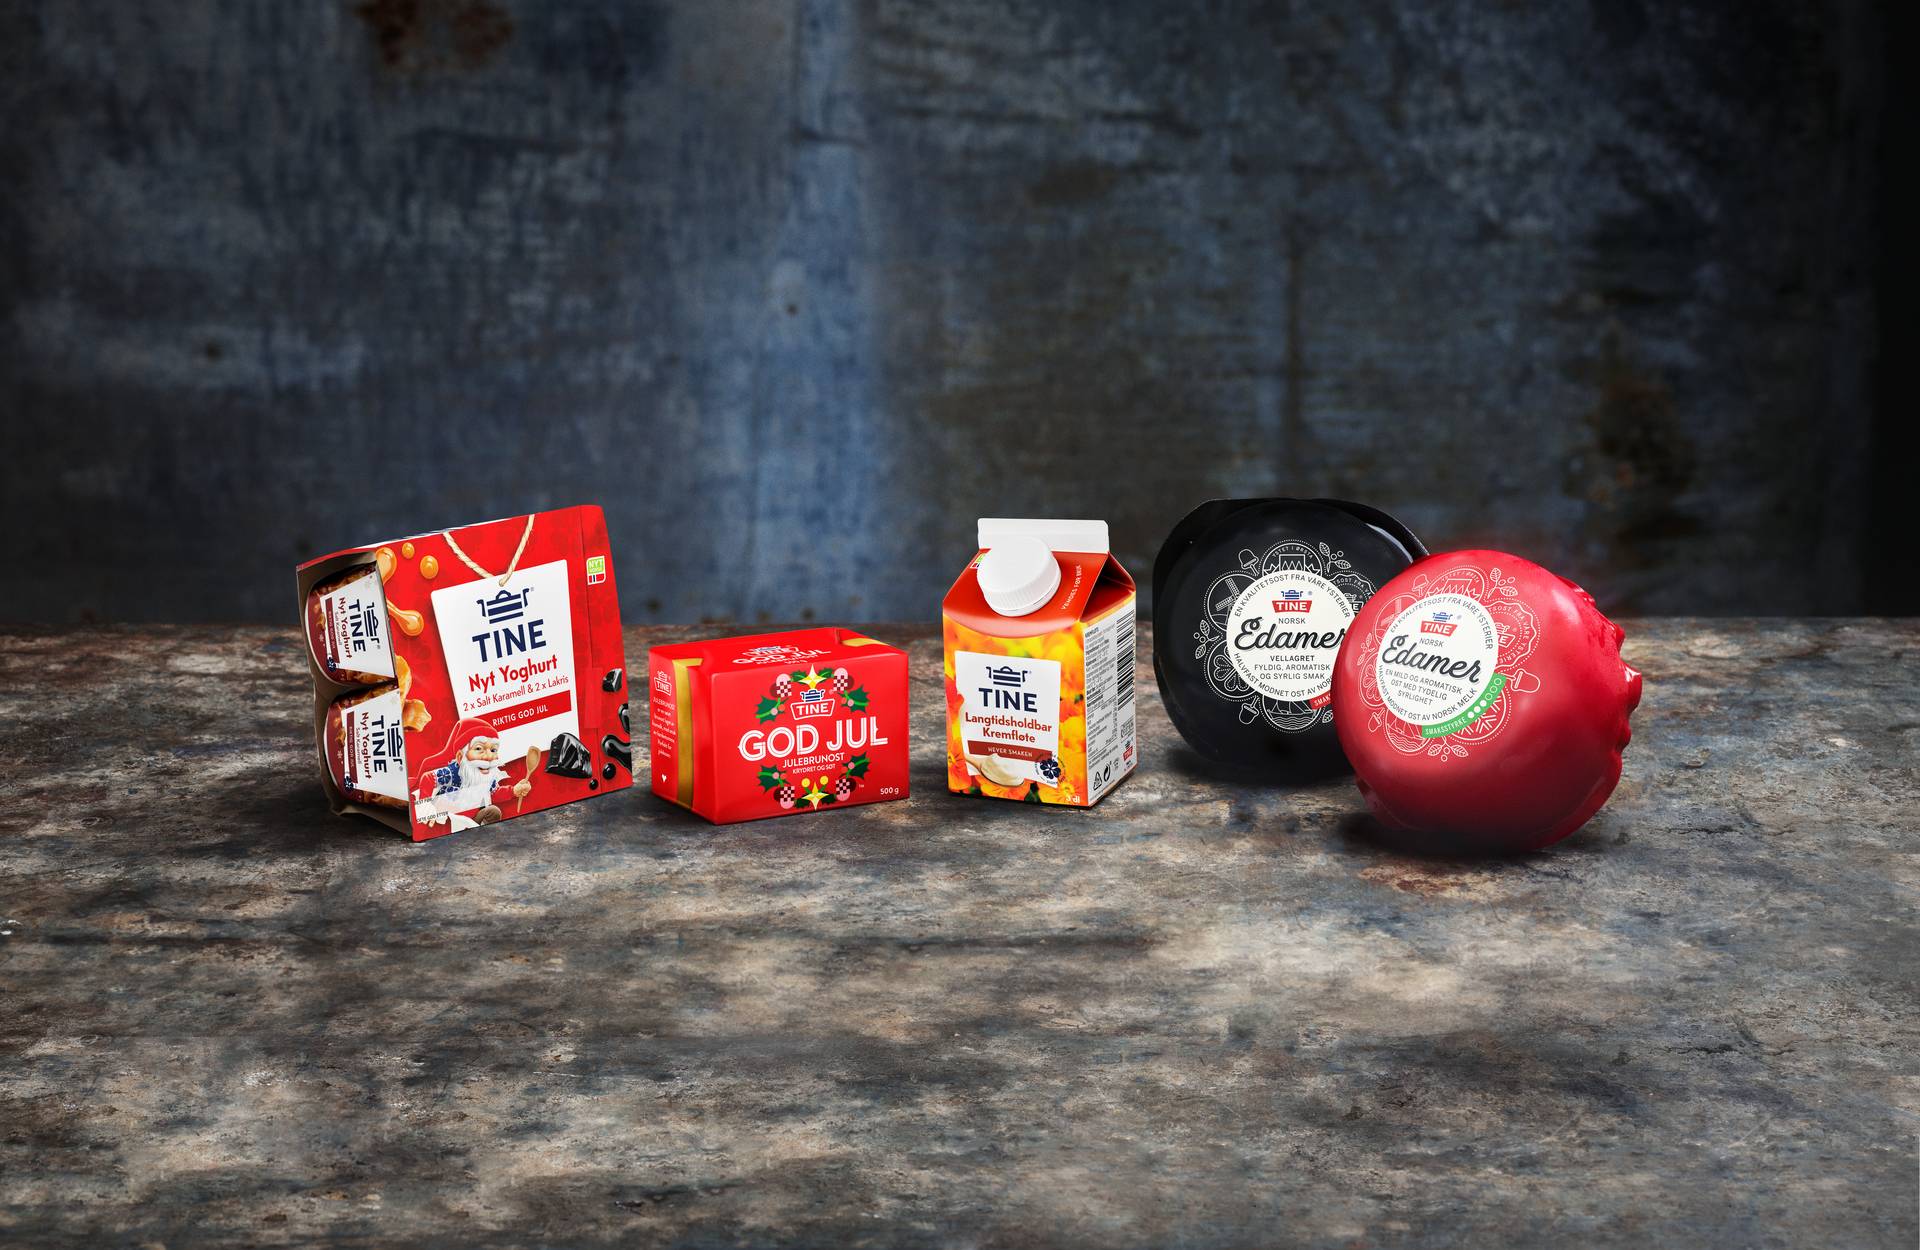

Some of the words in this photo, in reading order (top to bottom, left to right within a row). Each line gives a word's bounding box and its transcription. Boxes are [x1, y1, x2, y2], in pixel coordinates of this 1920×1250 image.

[1272, 546, 1288, 557] YSTET
[589, 559, 602, 568] NYT
[1061, 589, 1077, 609] VENDES
[1234, 606, 1243, 617] EN
[1240, 574, 1289, 606] KVALITETSOST
[1325, 586, 1351, 618] YSTERIER
[338, 597, 346, 615] Nyt
[1276, 602, 1307, 610] TINE
[1513, 609, 1525, 620] FRA
[349, 599, 366, 652] TINE
[1390, 624, 1398, 633] EN
[1397, 597, 1446, 624] KVALITETSOST
[1462, 600, 1479, 615] VÅRE
[1477, 613, 1493, 650] YSTERIER
[1424, 622, 1452, 634] TINE
[341, 617, 352, 658] Yoghurt
[472, 619, 546, 662] TINE
[1420, 638, 1444, 647] NORSK
[733, 654, 785, 664] GOD
[1382, 634, 1481, 684] Edamer
[468, 671, 495, 694] Nyt
[499, 654, 557, 683] Yoghurt
[1234, 653, 1259, 684] HALVFAST
[1258, 682, 1289, 697] MODNET
[1307, 687, 1316, 695] AV
[1394, 670, 1408, 679] MILD
[1420, 677, 1463, 694] AROMATISK
[463, 702, 469, 712] 2
[476, 695, 491, 708] Salt
[492, 686, 526, 703] Karamell
[528, 684, 534, 694] &
[535, 683, 540, 692] 2
[548, 675, 569, 688] Lakris
[657, 681, 670, 692] TINE
[1378, 665, 1389, 696] HALVFAST
[1387, 696, 1407, 716] MODNET
[1408, 712, 1420, 720] OST
[1432, 705, 1458, 720] NORSK
[1457, 688, 1477, 707] MELK
[1403, 682, 1416, 691] MED
[1418, 686, 1447, 700] TYDELIG
[978, 687, 1037, 713] TINE
[1314, 693, 1331, 706] SMAK
[1398, 690, 1433, 705] SYRLIGHET
[492, 713, 516, 727] RIKTIG
[518, 707, 534, 719] GOD
[536, 704, 548, 714] JUL
[796, 703, 829, 716] TINE
[360, 712, 369, 731] Nyt
[965, 712, 1052, 732] Langtidsholdbar
[1426, 717, 1467, 735] SMAKSSTYRKE
[372, 715, 387, 773] TINE
[737, 724, 819, 761] GOD
[826, 716, 888, 751] JUL
[983, 727, 1036, 743] Kremfløte
[362, 733, 372, 779] Yoghurt
[783, 752, 845, 768] JULEBRUNOST
[1008, 748, 1033, 757] SMAKEN
[792, 766, 816, 774] KRYDRET
